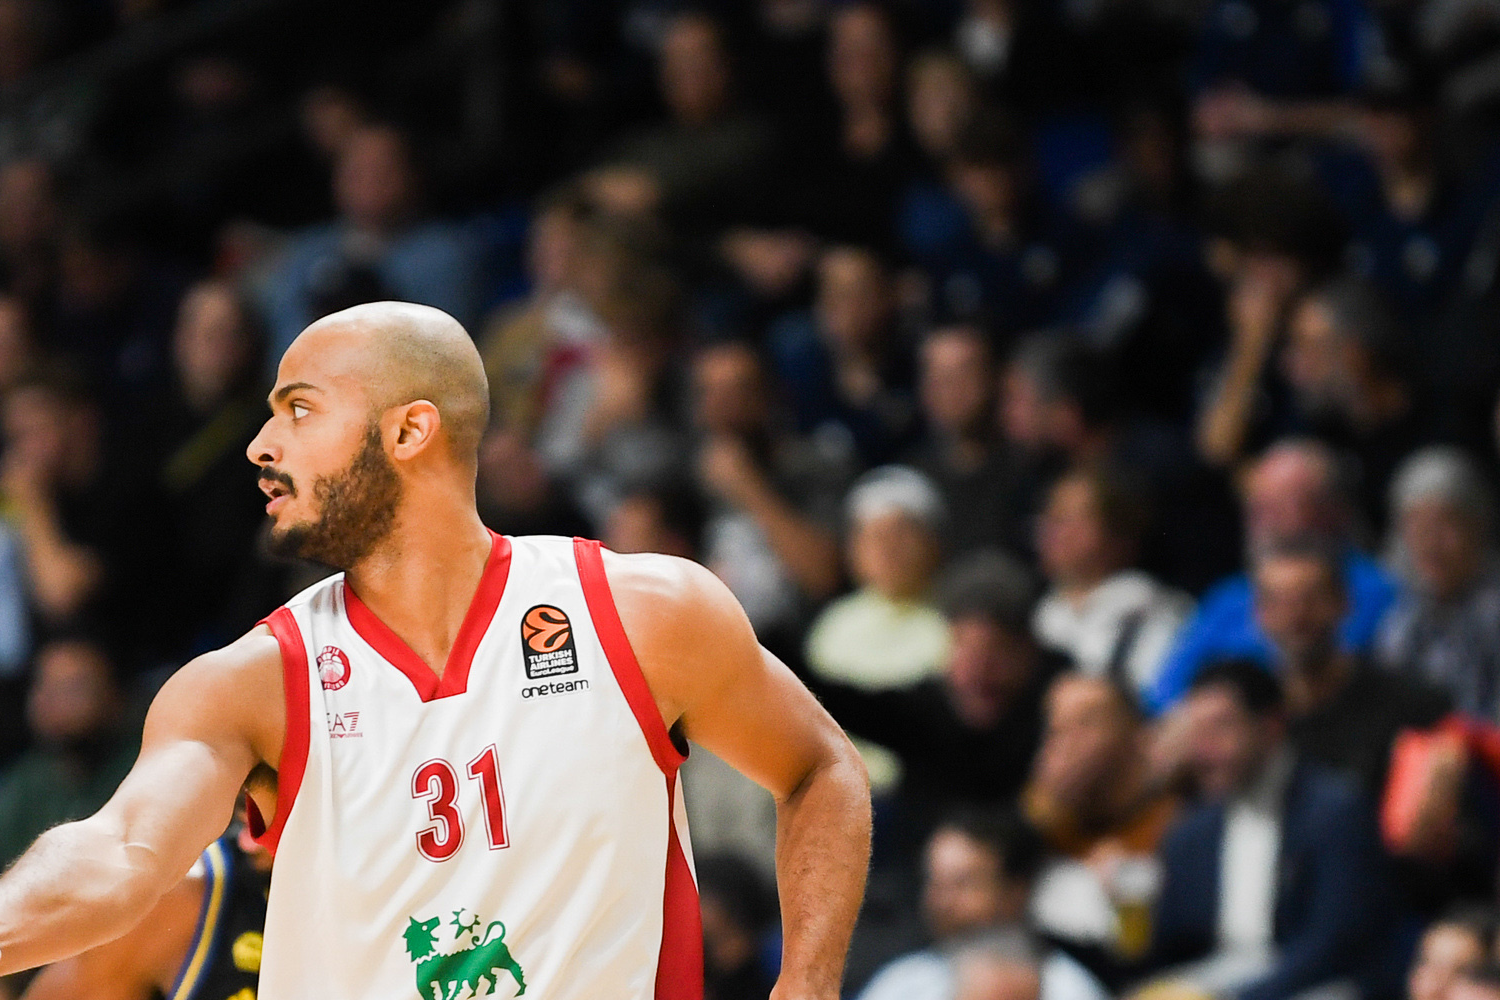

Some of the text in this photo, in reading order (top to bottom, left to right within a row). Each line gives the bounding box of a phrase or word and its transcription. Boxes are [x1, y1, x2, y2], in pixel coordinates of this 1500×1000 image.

[528, 649, 573, 663] TURKISH
[529, 657, 574, 671] AIRLINES
[410, 742, 511, 864] 31
